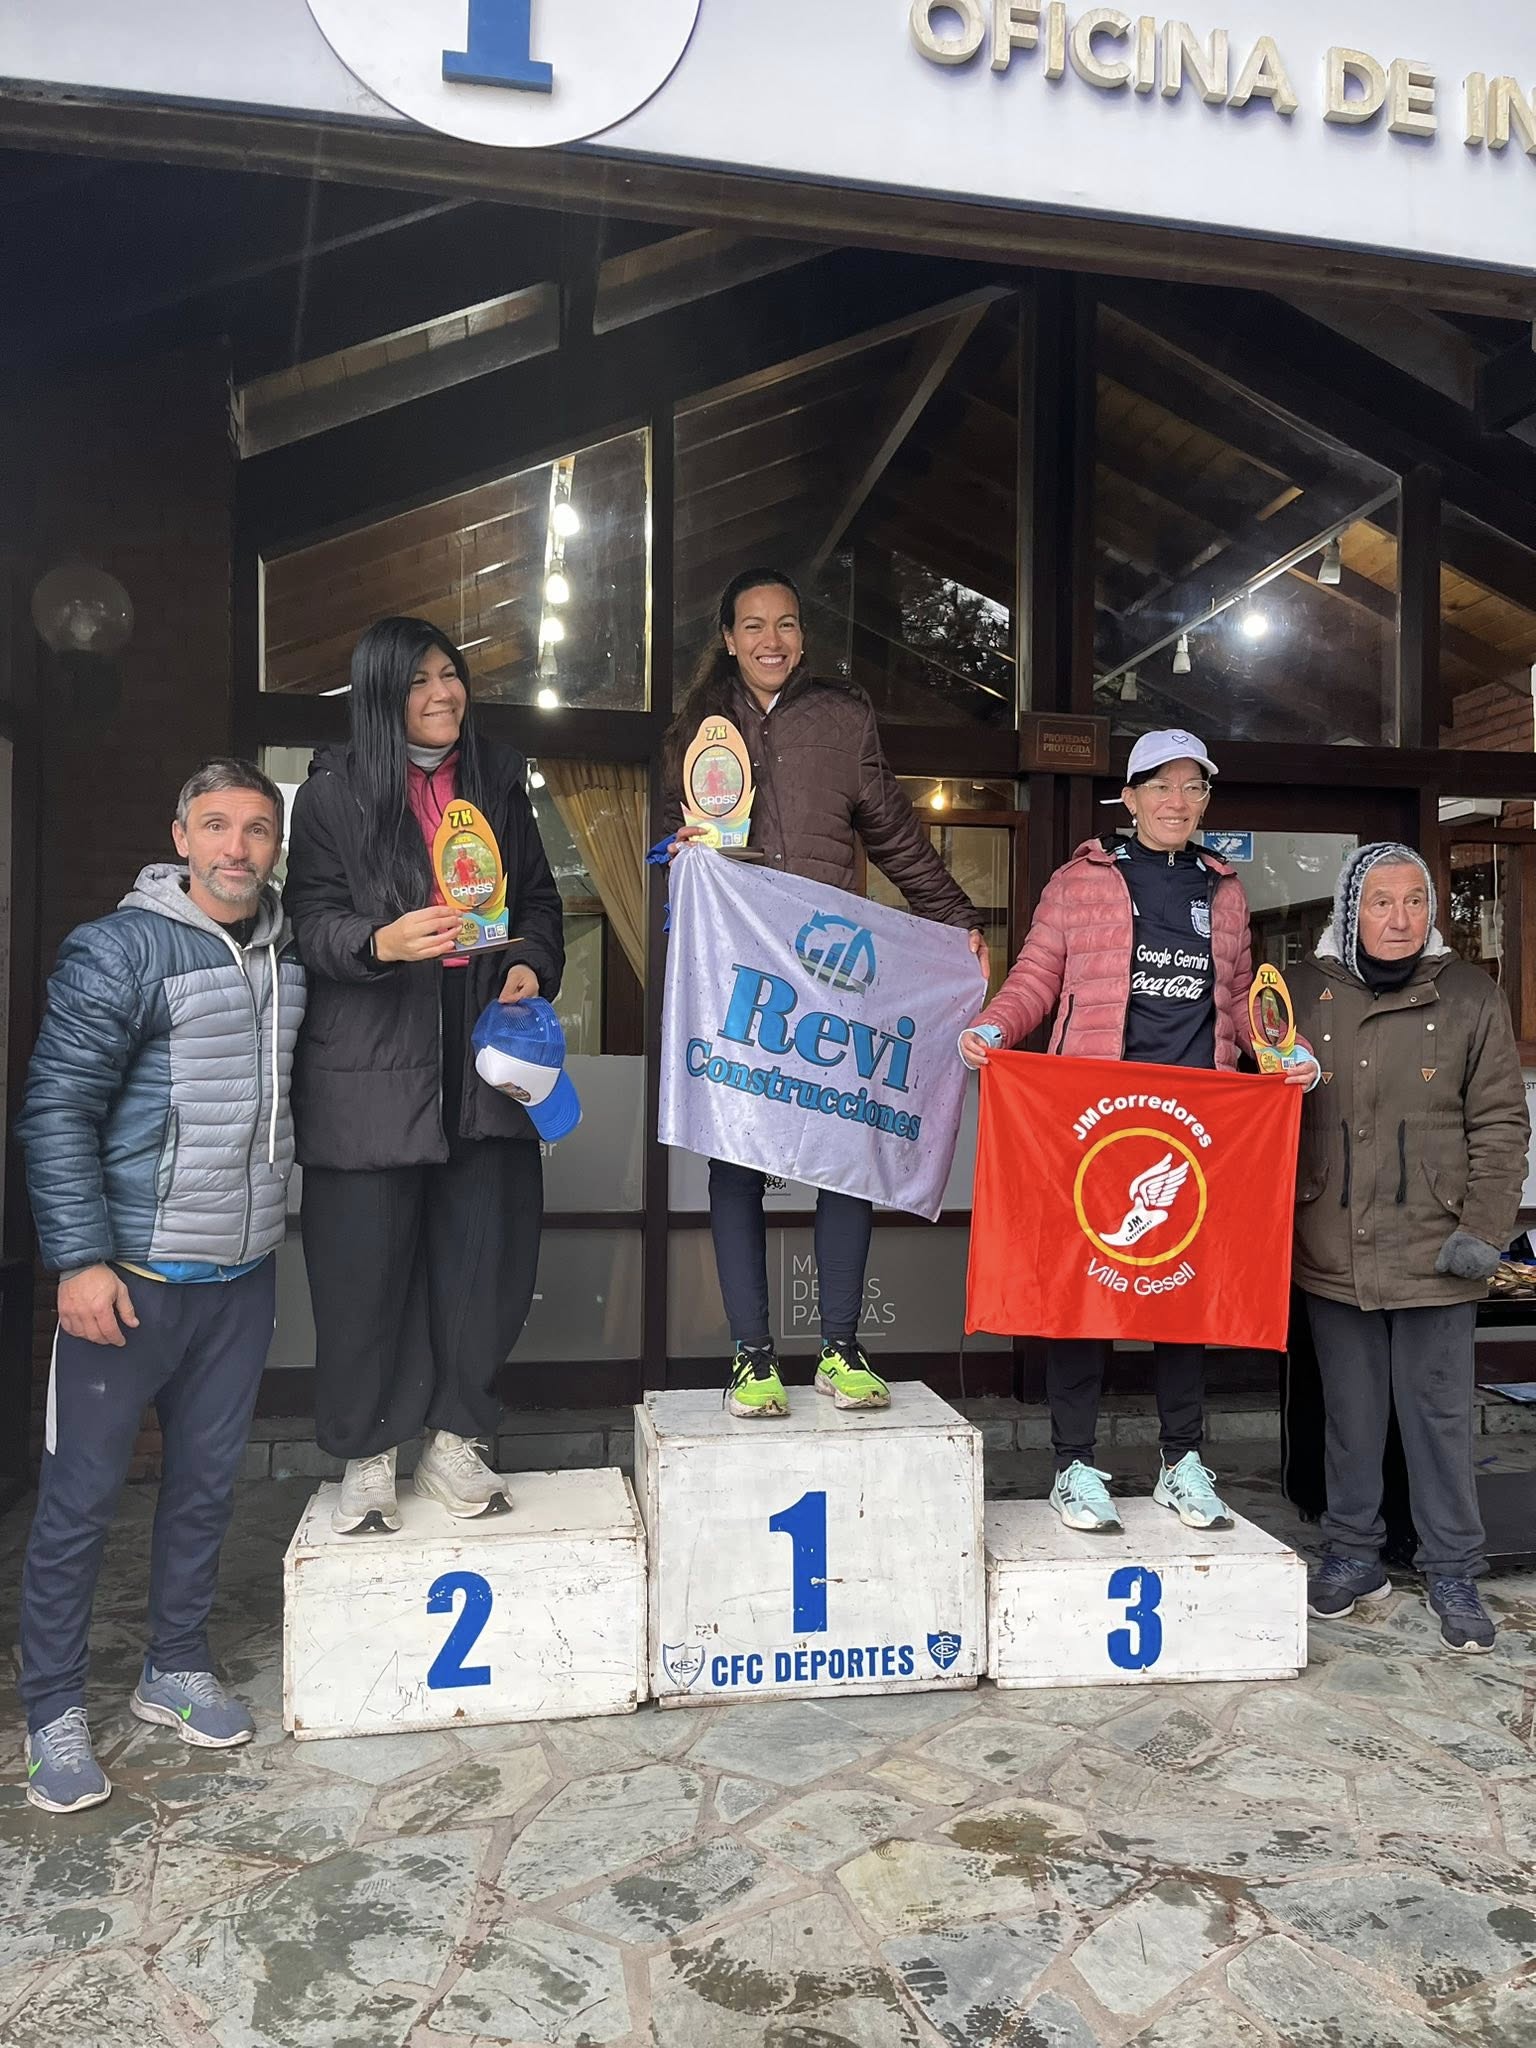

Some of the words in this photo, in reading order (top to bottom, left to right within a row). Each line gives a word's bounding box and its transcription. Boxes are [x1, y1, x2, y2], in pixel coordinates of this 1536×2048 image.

[908, 0, 1299, 114] OFICINA
[1322, 46, 1438, 136] DE
[706, 725, 727, 741] 7K
[1043, 733, 1091, 744] PROPIEDAD
[1043, 743, 1091, 754] PROTEGIDA
[699, 794, 738, 806] CROSS
[448, 808, 474, 828] 7K
[451, 883, 494, 897] CROSS
[1136, 944, 1172, 969] Google
[1173, 949, 1210, 971] Gemini
[1261, 970, 1278, 984] 7K
[717, 963, 916, 1093] Revi
[686, 1037, 922, 1142] Construcciones
[1127, 1215, 1143, 1232] JM
[1086, 1257, 1129, 1293] Villa
[1133, 1261, 1197, 1296] Gesell
[792, 1302, 896, 1326] PAAS
[769, 1491, 828, 1634] 1
[426, 1571, 493, 1690] 2
[1107, 1566, 1163, 1670] 3
[711, 1654, 763, 1687] CFC
[775, 1645, 915, 1683] DEPORTES
